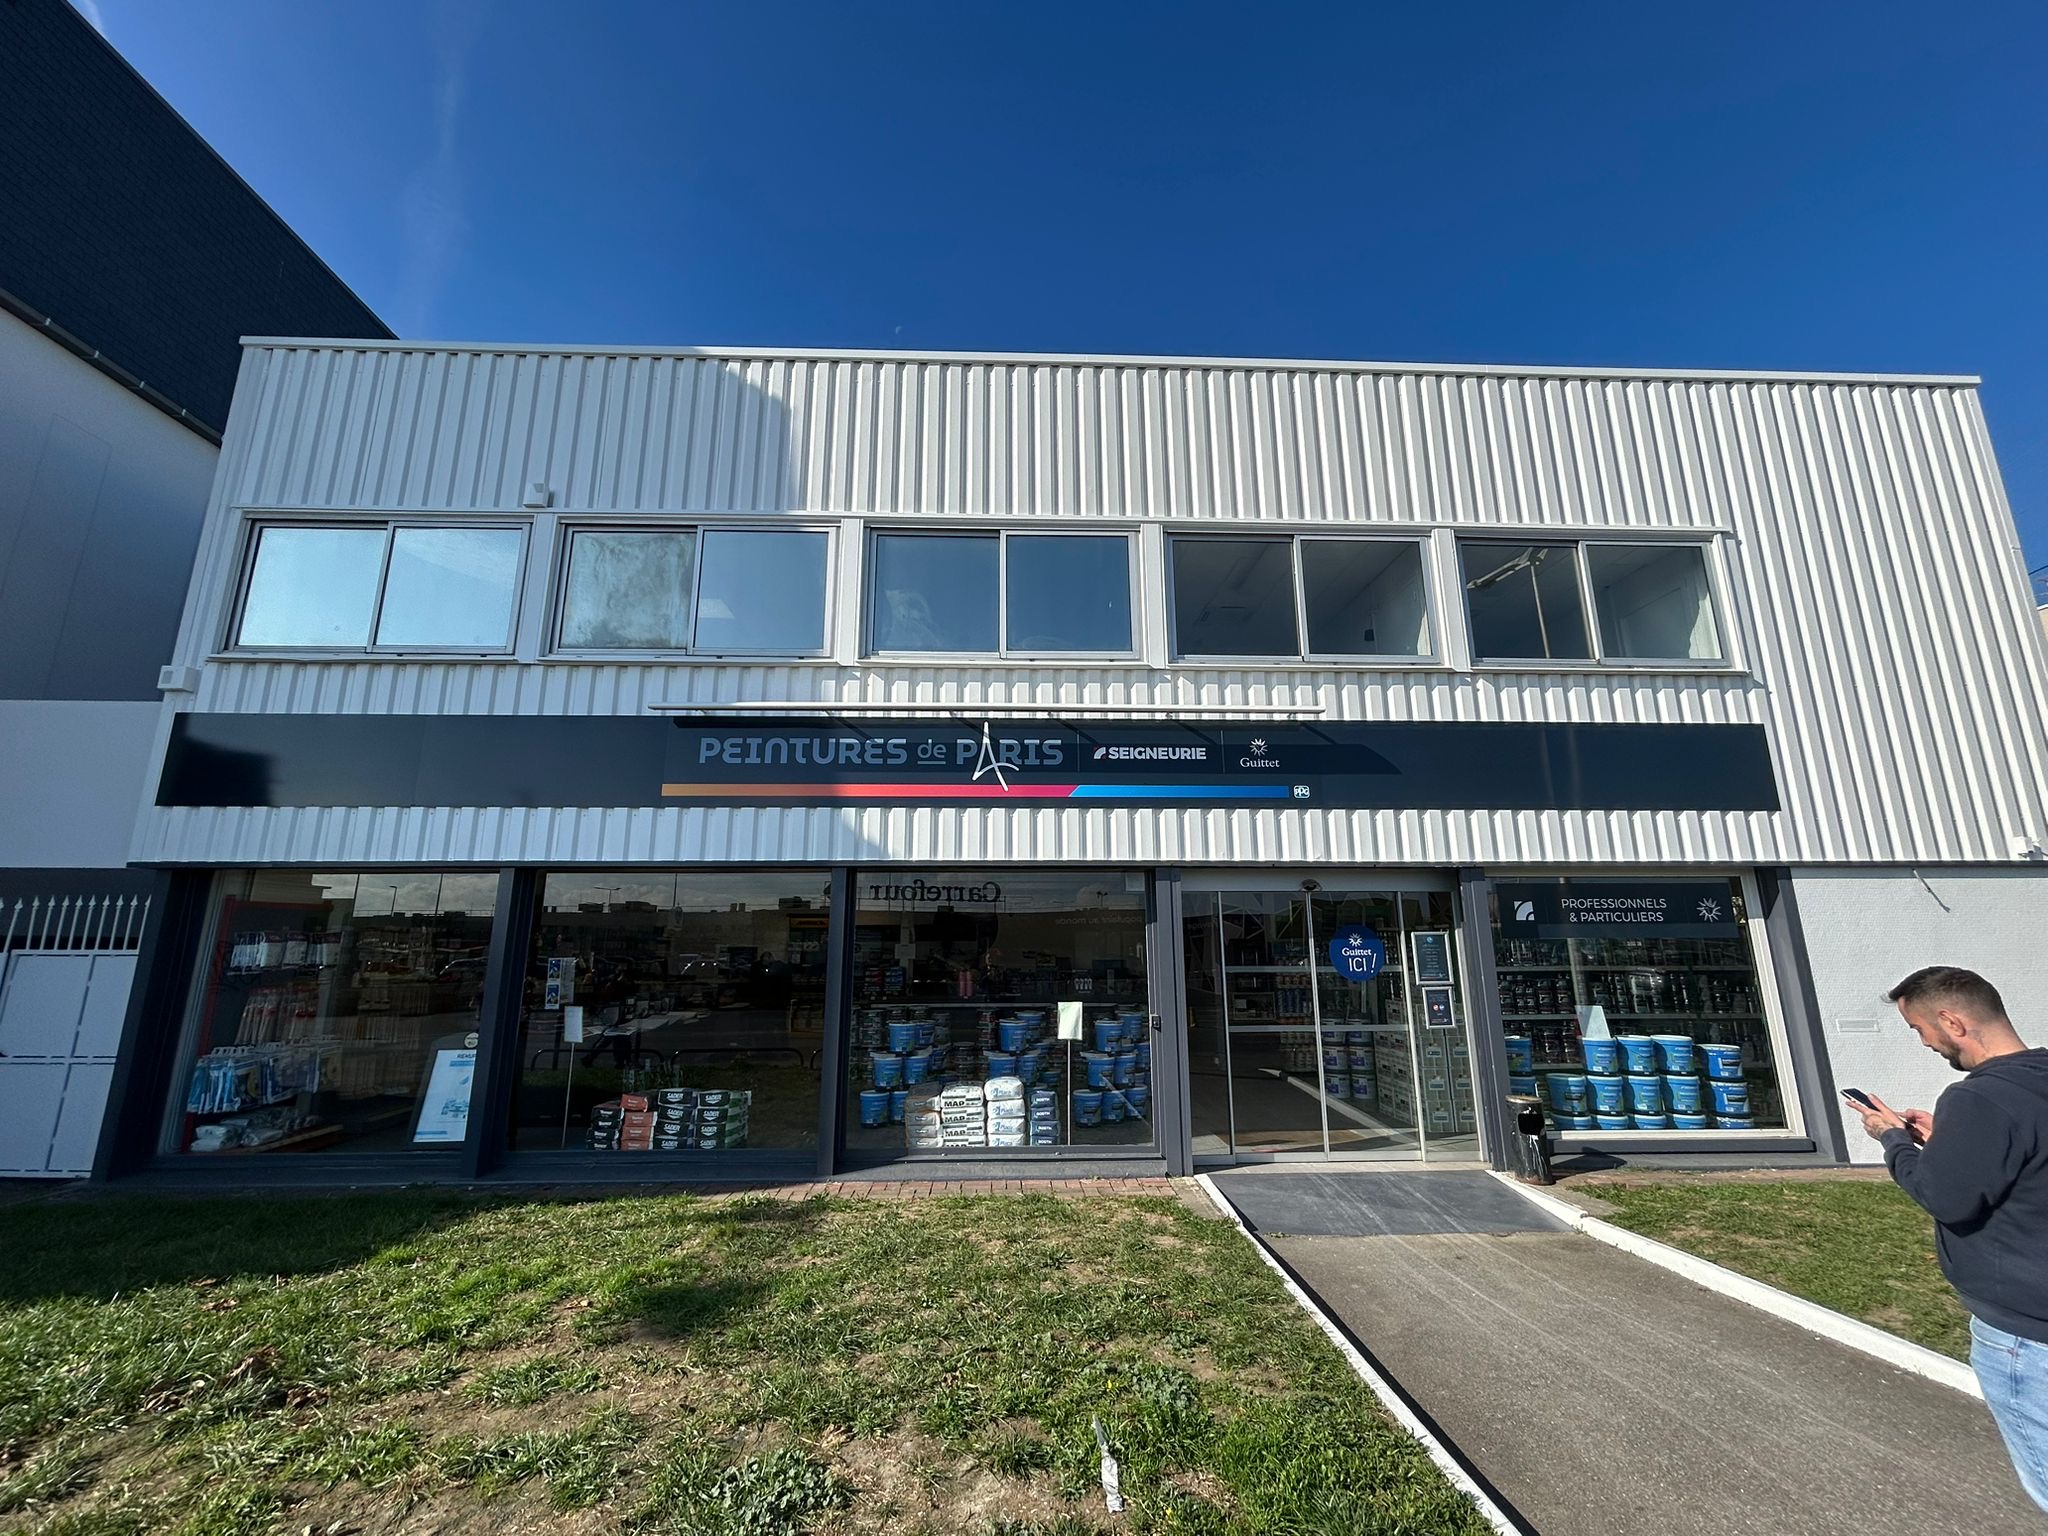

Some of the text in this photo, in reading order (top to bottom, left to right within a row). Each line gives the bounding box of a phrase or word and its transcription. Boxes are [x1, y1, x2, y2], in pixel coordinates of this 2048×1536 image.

[699, 737, 908, 765] PEINTURES
[917, 738, 947, 760] de
[1108, 746, 1207, 760] SEIGNEURIE
[1240, 757, 1280, 768] Guittet
[1561, 898, 1667, 909] PROFESSIONNELS
[1569, 911, 1664, 922] & PARTICULIERS
[1342, 947, 1372, 956] Guittet
